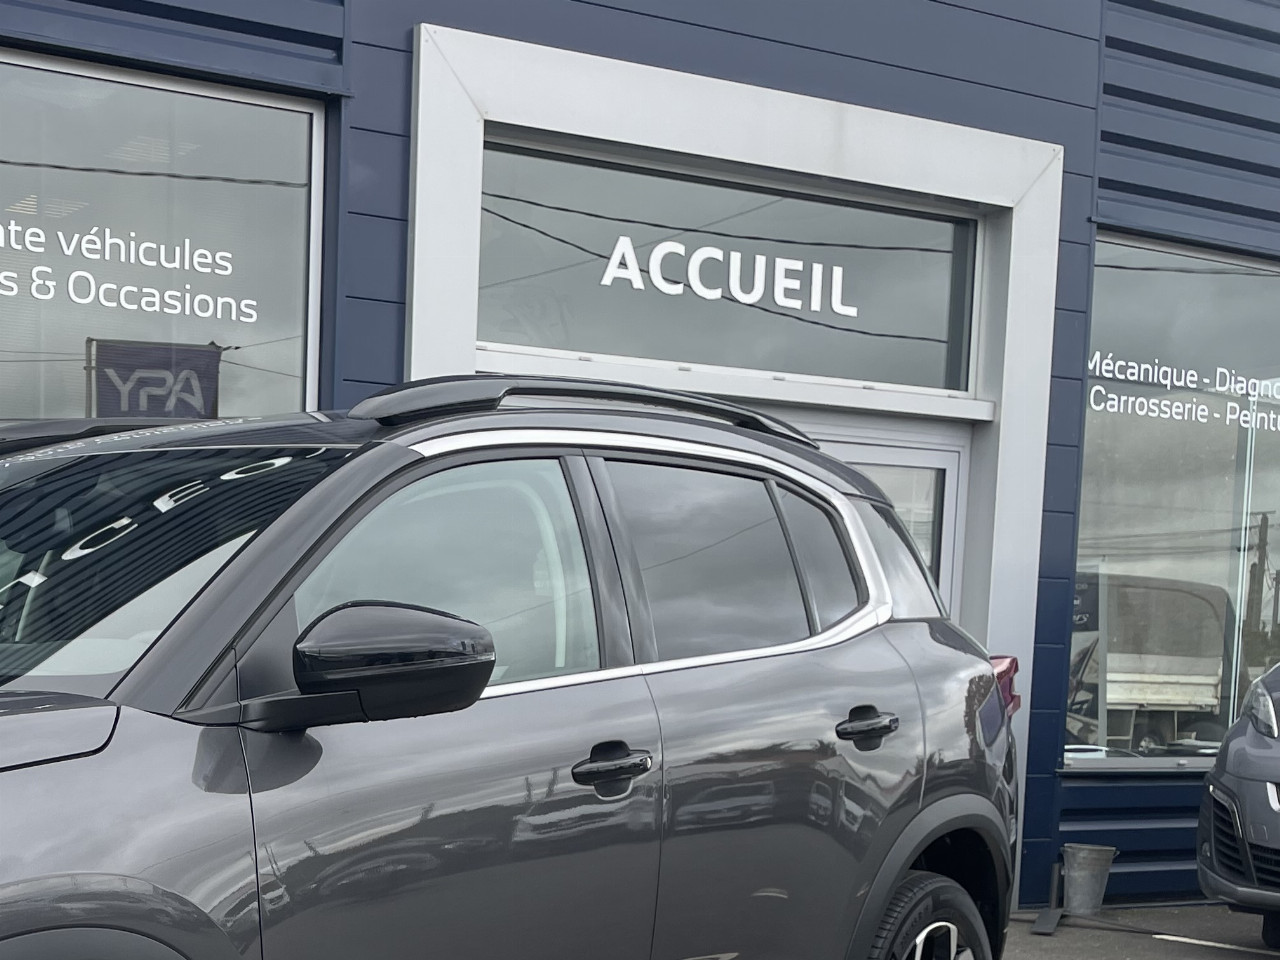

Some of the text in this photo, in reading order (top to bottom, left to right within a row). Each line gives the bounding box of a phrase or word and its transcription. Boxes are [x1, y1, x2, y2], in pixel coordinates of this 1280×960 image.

[56, 226, 234, 277] véhicules
[30, 266, 56, 300] &
[67, 271, 259, 324] Occasions
[600, 235, 858, 318] ACCUEIL
[104, 368, 205, 416] YPA
[1088, 351, 1198, 390] Mécanique
[1089, 385, 1209, 423] Carrosserie
